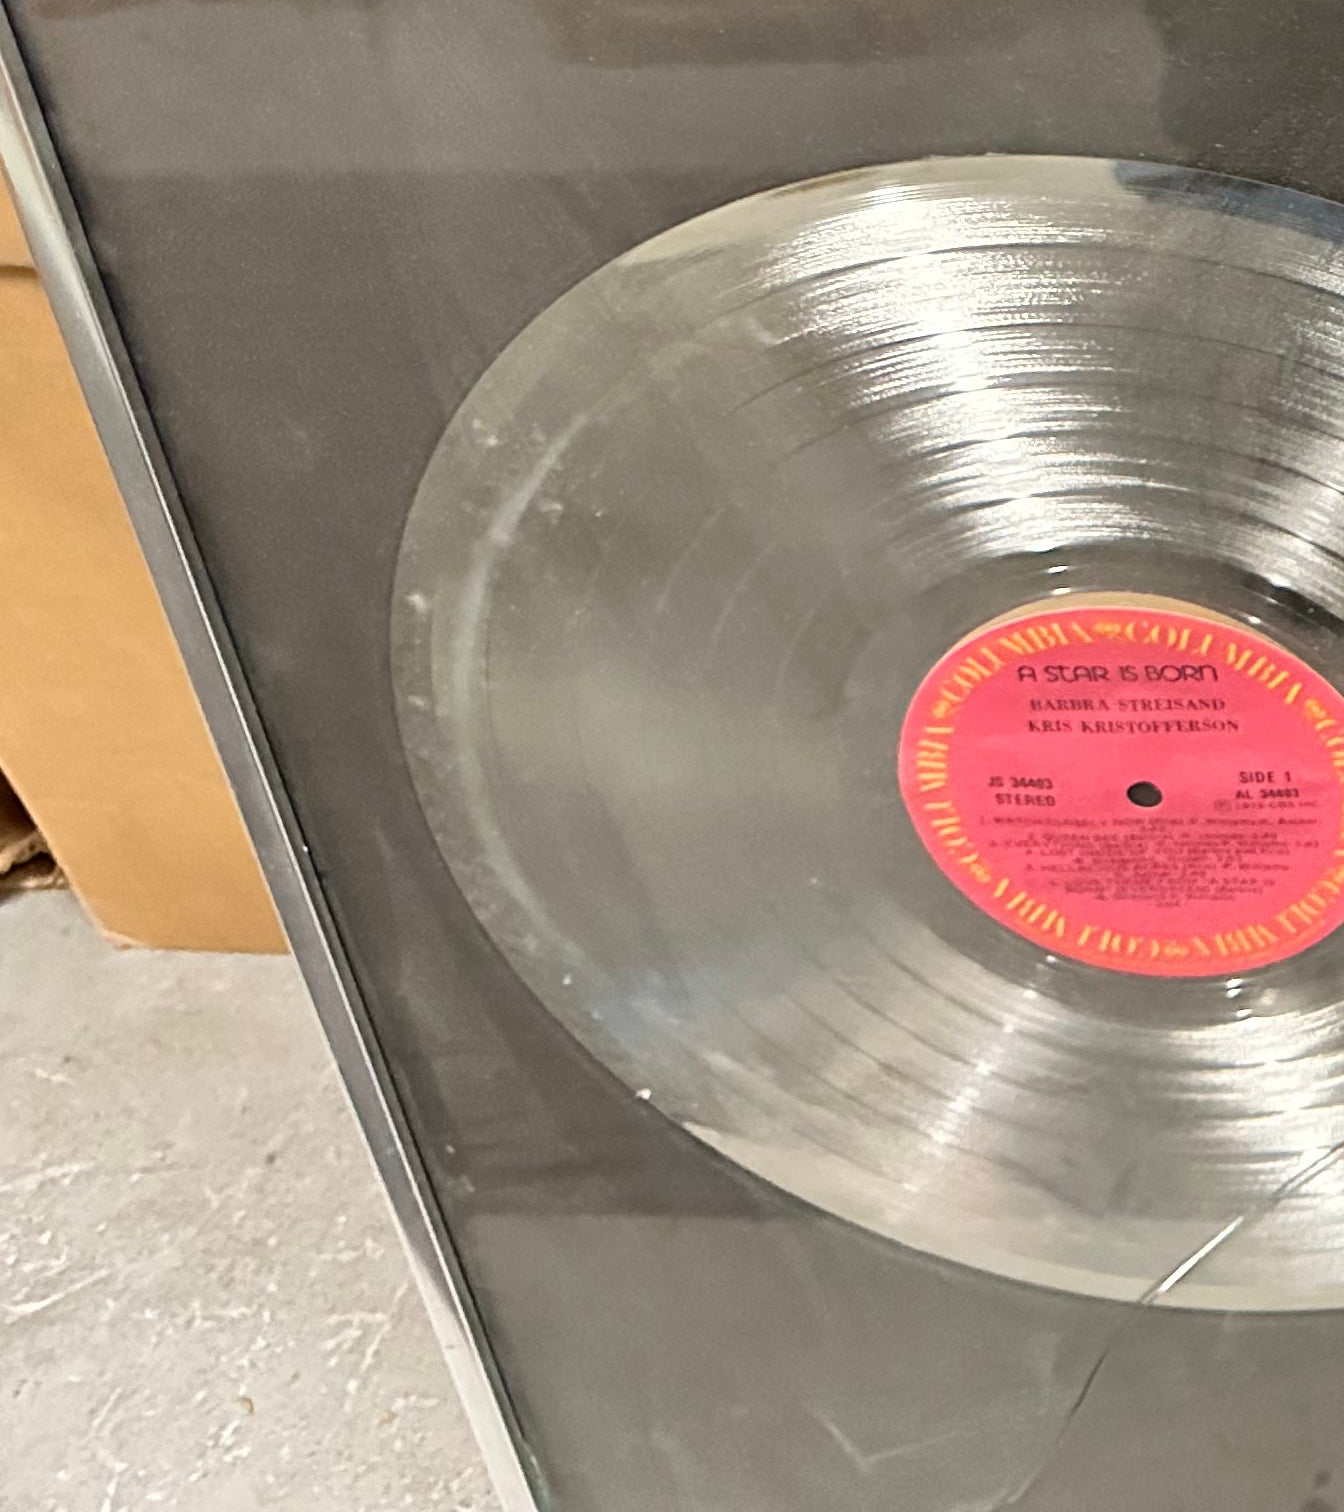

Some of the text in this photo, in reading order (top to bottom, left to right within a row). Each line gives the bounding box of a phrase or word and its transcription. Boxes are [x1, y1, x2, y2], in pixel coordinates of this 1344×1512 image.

[941, 621, 1093, 701] COLUMBIA
[1017, 666, 1036, 682] A
[1119, 665, 1138, 682] IS
[1124, 620, 1303, 705] COLUMBIA
[1028, 719, 1239, 734] KRIS KRISTOFFERSON
[1030, 698, 1226, 712] BARBRA STREISAND
[916, 725, 975, 864] COLUMBIA
[995, 793, 1056, 807] STEREO
[1239, 770, 1291, 784] SIDE 1
[992, 876, 1160, 958] COLUMBIA
[1190, 881, 1342, 957] COLUMBIA
